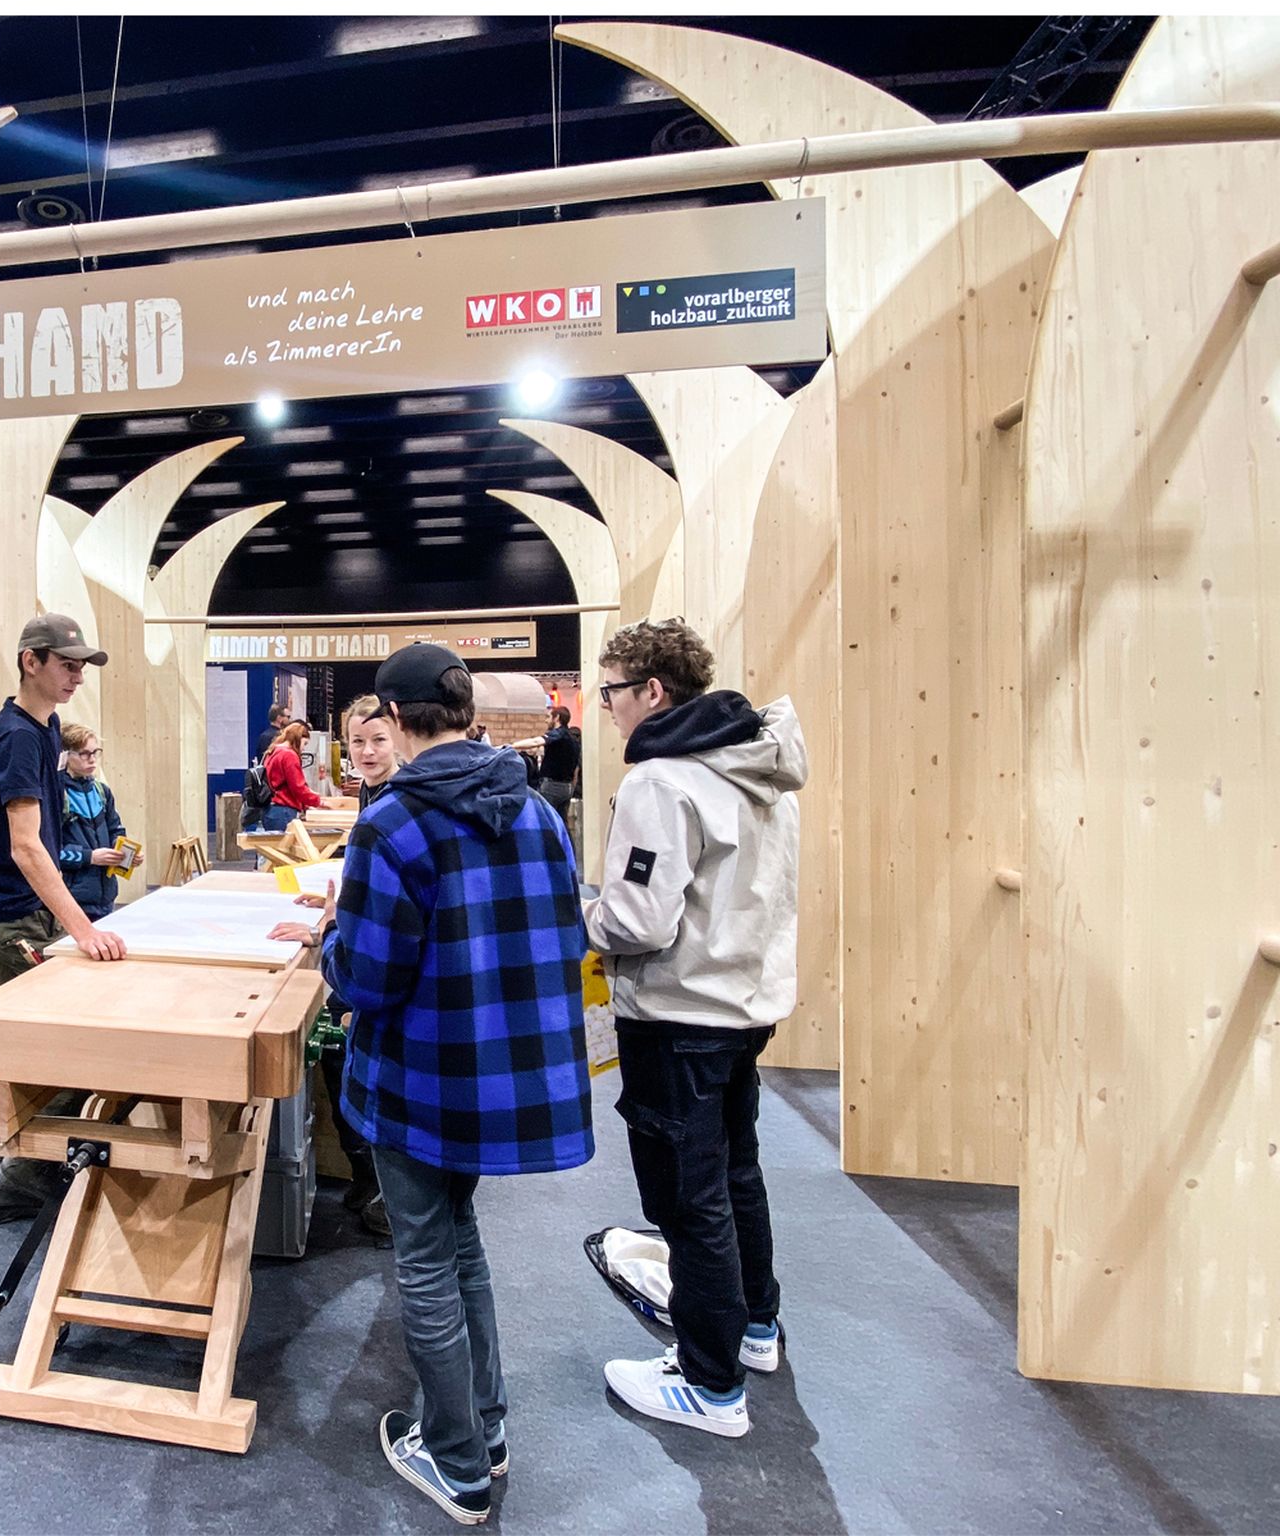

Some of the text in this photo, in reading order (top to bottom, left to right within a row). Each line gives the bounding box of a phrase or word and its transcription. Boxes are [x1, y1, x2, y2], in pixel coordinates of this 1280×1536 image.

[247, 280, 355, 308] und mach
[684, 287, 792, 308] vorarlberger
[288, 304, 424, 333] deine Lehre
[467, 290, 563, 325] WKO
[650, 300, 791, 326] holzbau_zukunft
[466, 321, 602, 338] WIRTSCHAFTSKAMMER VORARLBERG
[570, 330, 603, 338] Holzbau
[223, 331, 402, 366] als ZimmererIn
[209, 634, 390, 658] NIMM'S IN D'HAND
